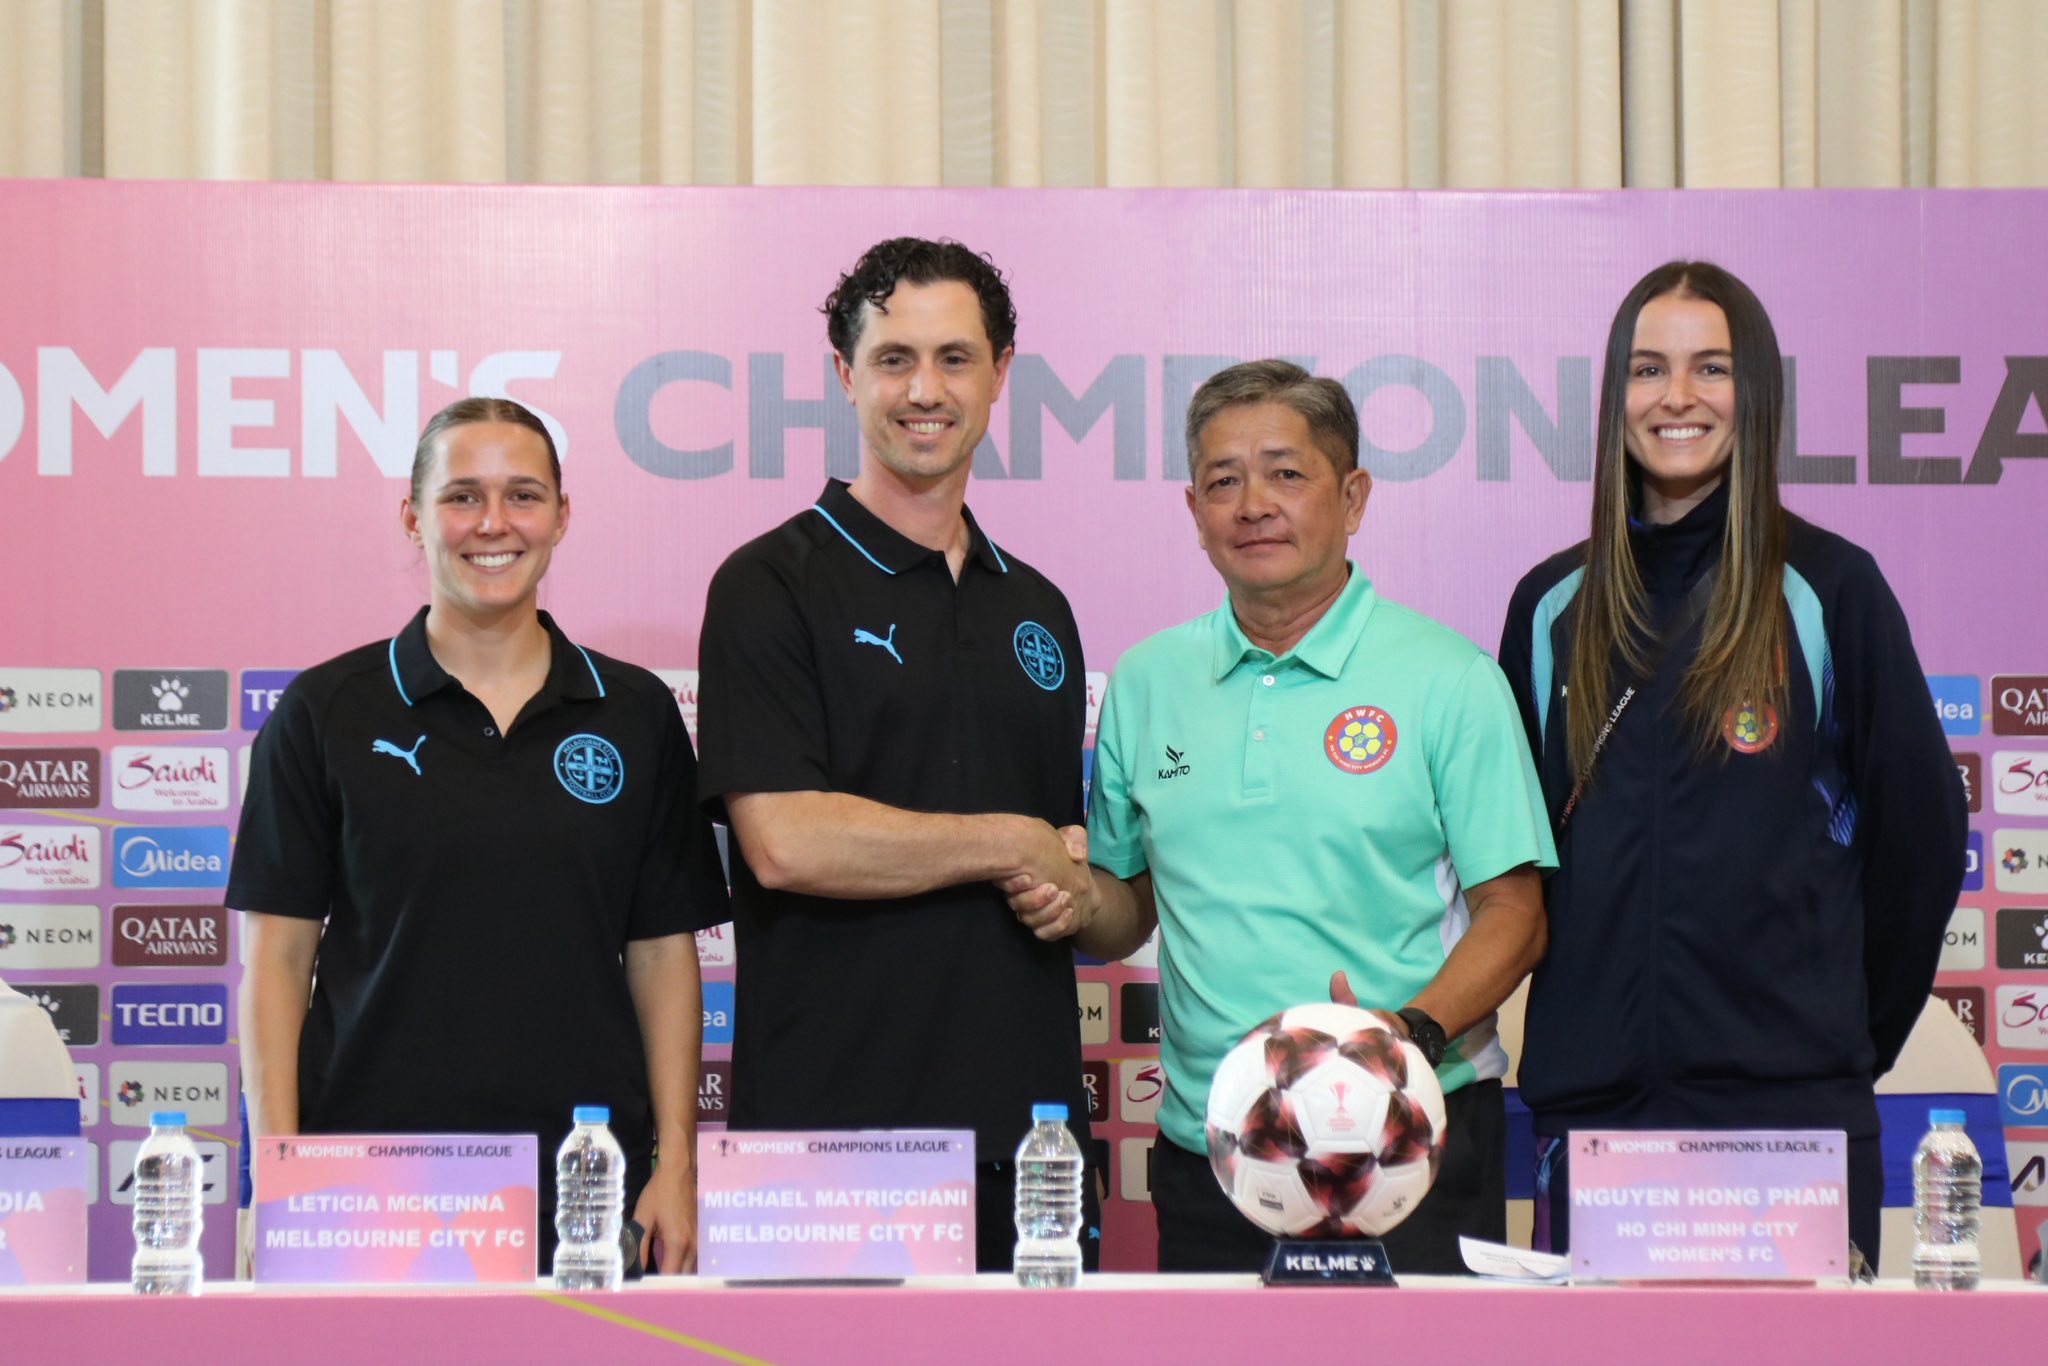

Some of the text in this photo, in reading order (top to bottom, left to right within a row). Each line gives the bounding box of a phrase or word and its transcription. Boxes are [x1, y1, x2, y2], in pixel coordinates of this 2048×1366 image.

[27, 692, 94, 708] NEOM
[1609, 686, 1636, 723] LEAGUE
[140, 713, 200, 727] KELME
[0, 760, 90, 788] QATAR
[117, 752, 217, 790] Saudi
[16, 783, 91, 798] AIRWAYS
[122, 839, 222, 878] Midea
[26, 928, 93, 944] NEOM
[120, 917, 217, 944] QATAR
[1943, 931, 1977, 946] OM
[145, 941, 218, 956] AIRWAYS
[116, 1003, 223, 1026] TECNO
[154, 1087, 220, 1101] NEOM
[6, 1147, 62, 1159] LEAGUE
[297, 1144, 366, 1158] WOMEN'S
[368, 1145, 454, 1158] CHAMPIONS
[458, 1145, 512, 1158] LEAGUE
[737, 1141, 806, 1155] WOMEN'S
[808, 1141, 893, 1154] CHAMPIONS
[896, 1140, 950, 1153] LEAGUE
[1609, 1140, 1677, 1154] WOMEN'S
[1679, 1140, 1764, 1154] CHAMPIONS
[1767, 1140, 1821, 1153] LEAGUE
[288, 1195, 505, 1213] LETICIA MCKENNA
[704, 1189, 968, 1208] MICHAEL MATRICCIANI
[1575, 1187, 1840, 1207] NGUYEN HONG PHAM
[709, 1223, 965, 1243] MELBOURNE CITY FC
[1616, 1221, 1799, 1237] HO CHI MINH CITY
[266, 1229, 527, 1248] MELBOURNE CITY FC
[1648, 1246, 1775, 1263] WOMEN'S FC
[1285, 1255, 1359, 1272] KELME
